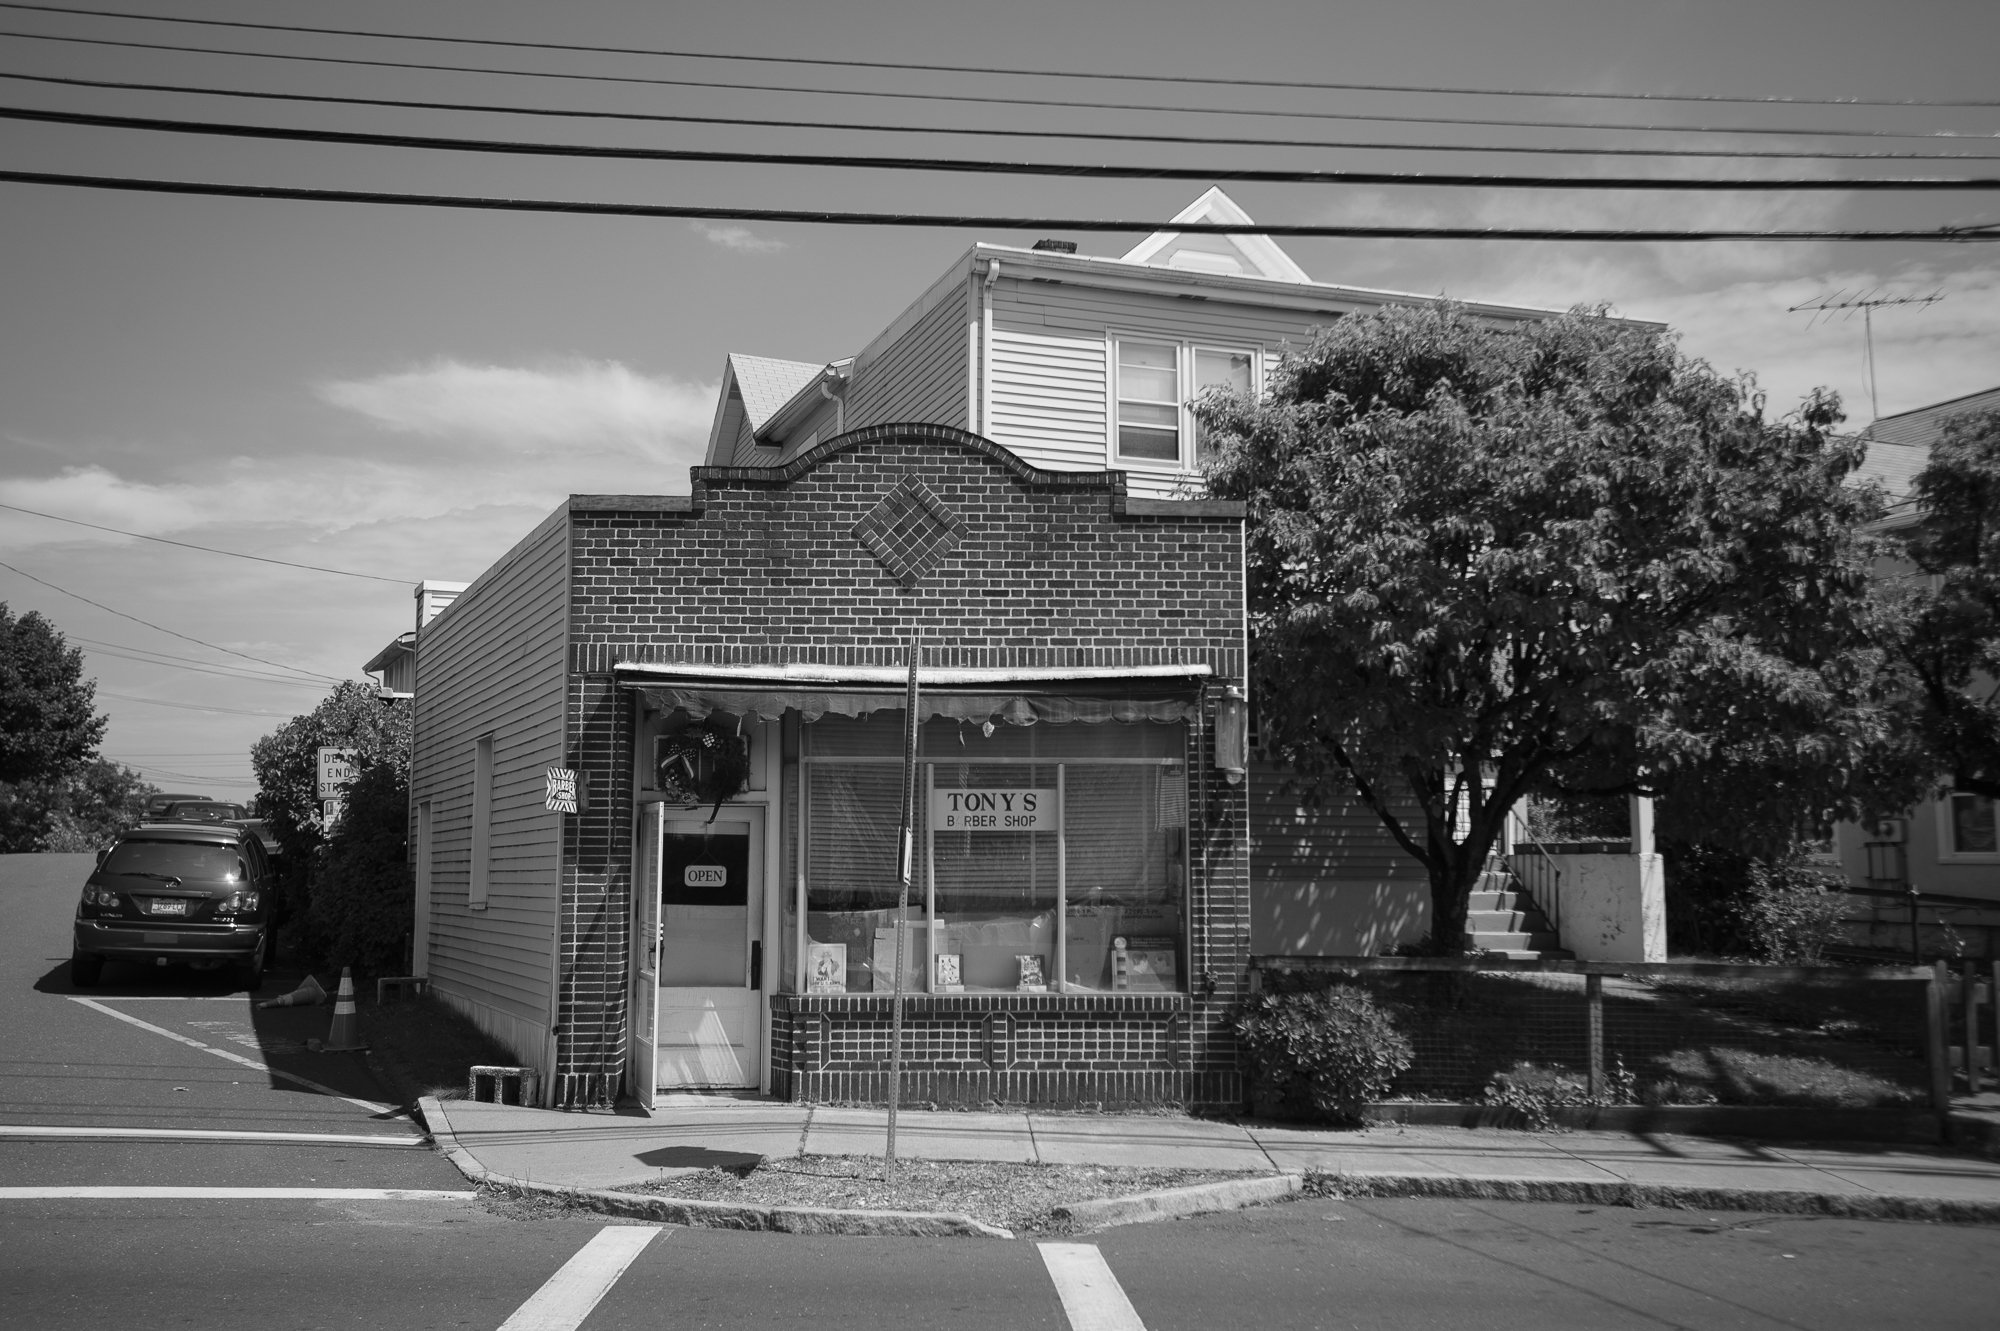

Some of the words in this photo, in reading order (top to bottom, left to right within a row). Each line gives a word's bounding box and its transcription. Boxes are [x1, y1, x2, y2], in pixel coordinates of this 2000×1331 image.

[327, 768, 350, 778] END
[551, 778, 577, 797] BARBER
[556, 790, 573, 800] SHOP
[947, 815, 997, 827] BRBER
[1004, 815, 1037, 827] SHOP
[688, 870, 723, 882] OPEN
